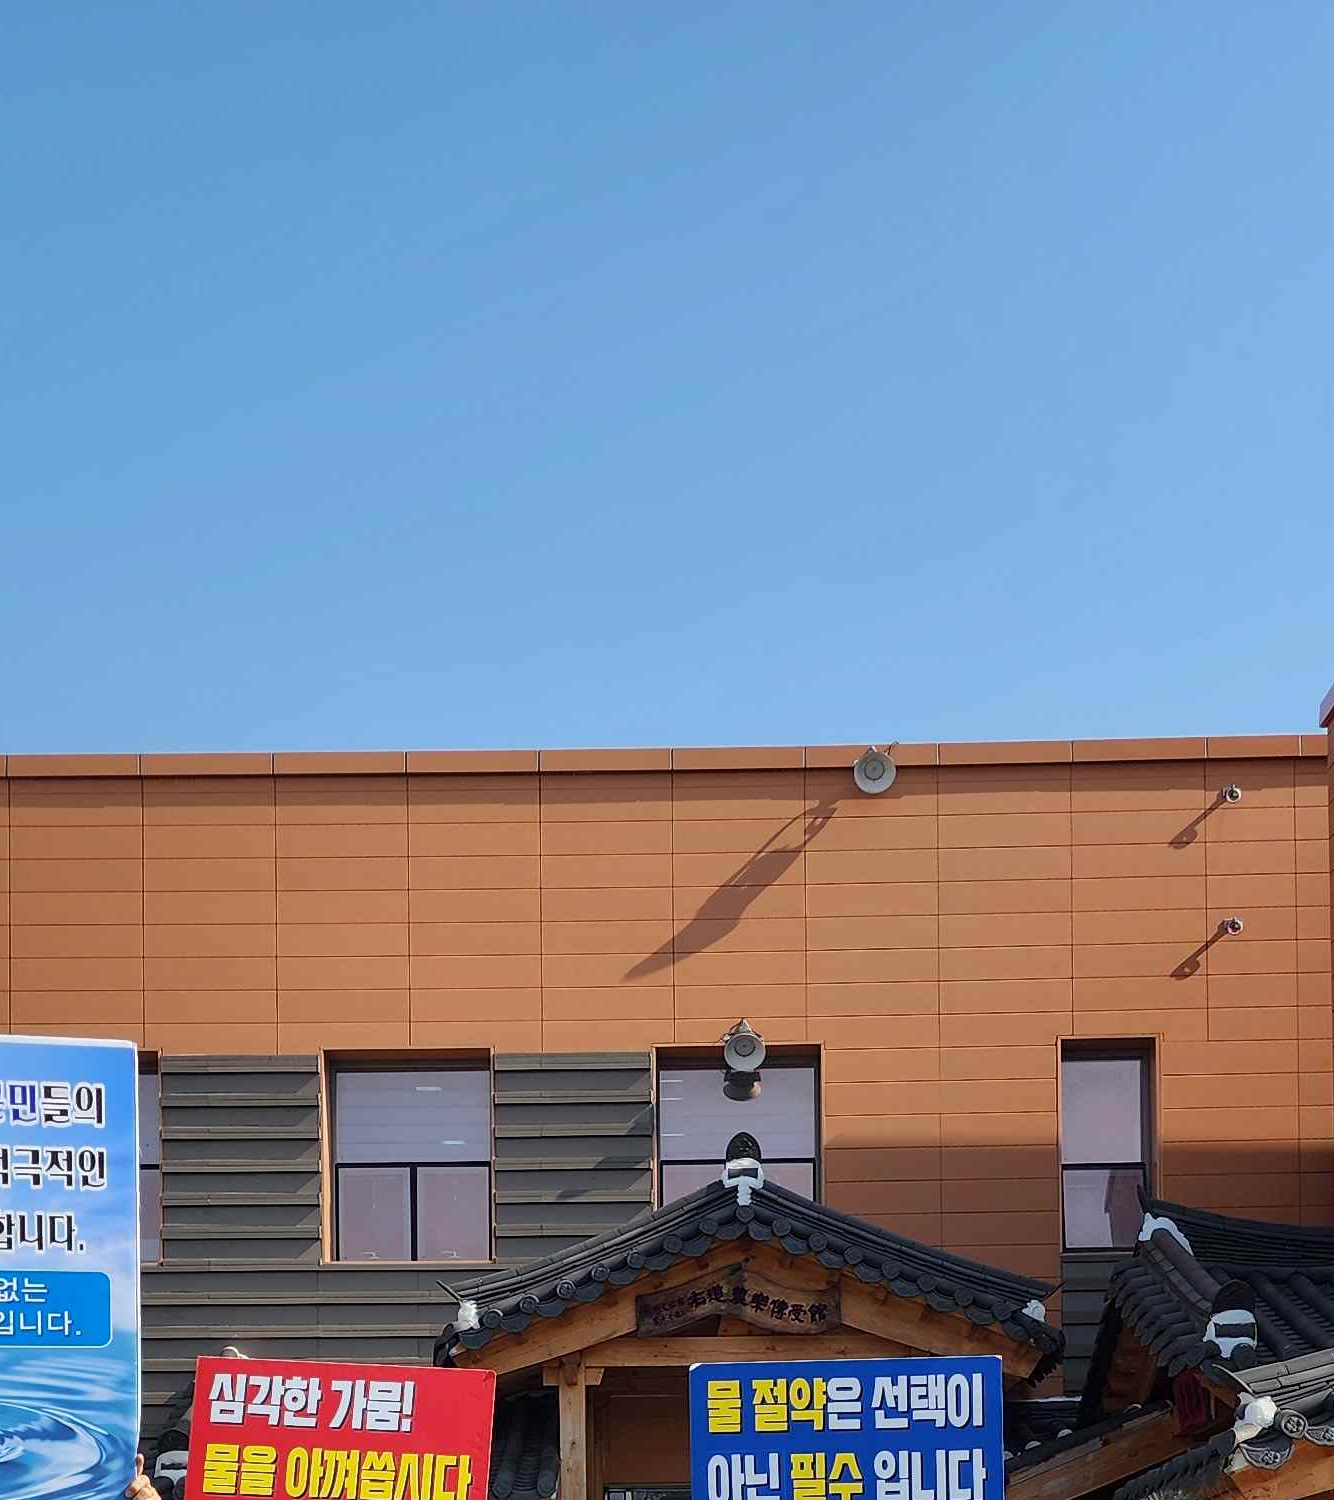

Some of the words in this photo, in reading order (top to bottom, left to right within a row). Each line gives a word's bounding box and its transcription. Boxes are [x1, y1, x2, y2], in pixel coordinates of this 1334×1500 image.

[208, 1373, 322, 1428] 심각한
[329, 1379, 416, 1432] 가뭄!
[707, 1379, 743, 1433] 물
[752, 1376, 863, 1432] 절약은
[871, 1372, 985, 1430] 선택이
[203, 1443, 278, 1496] 물을
